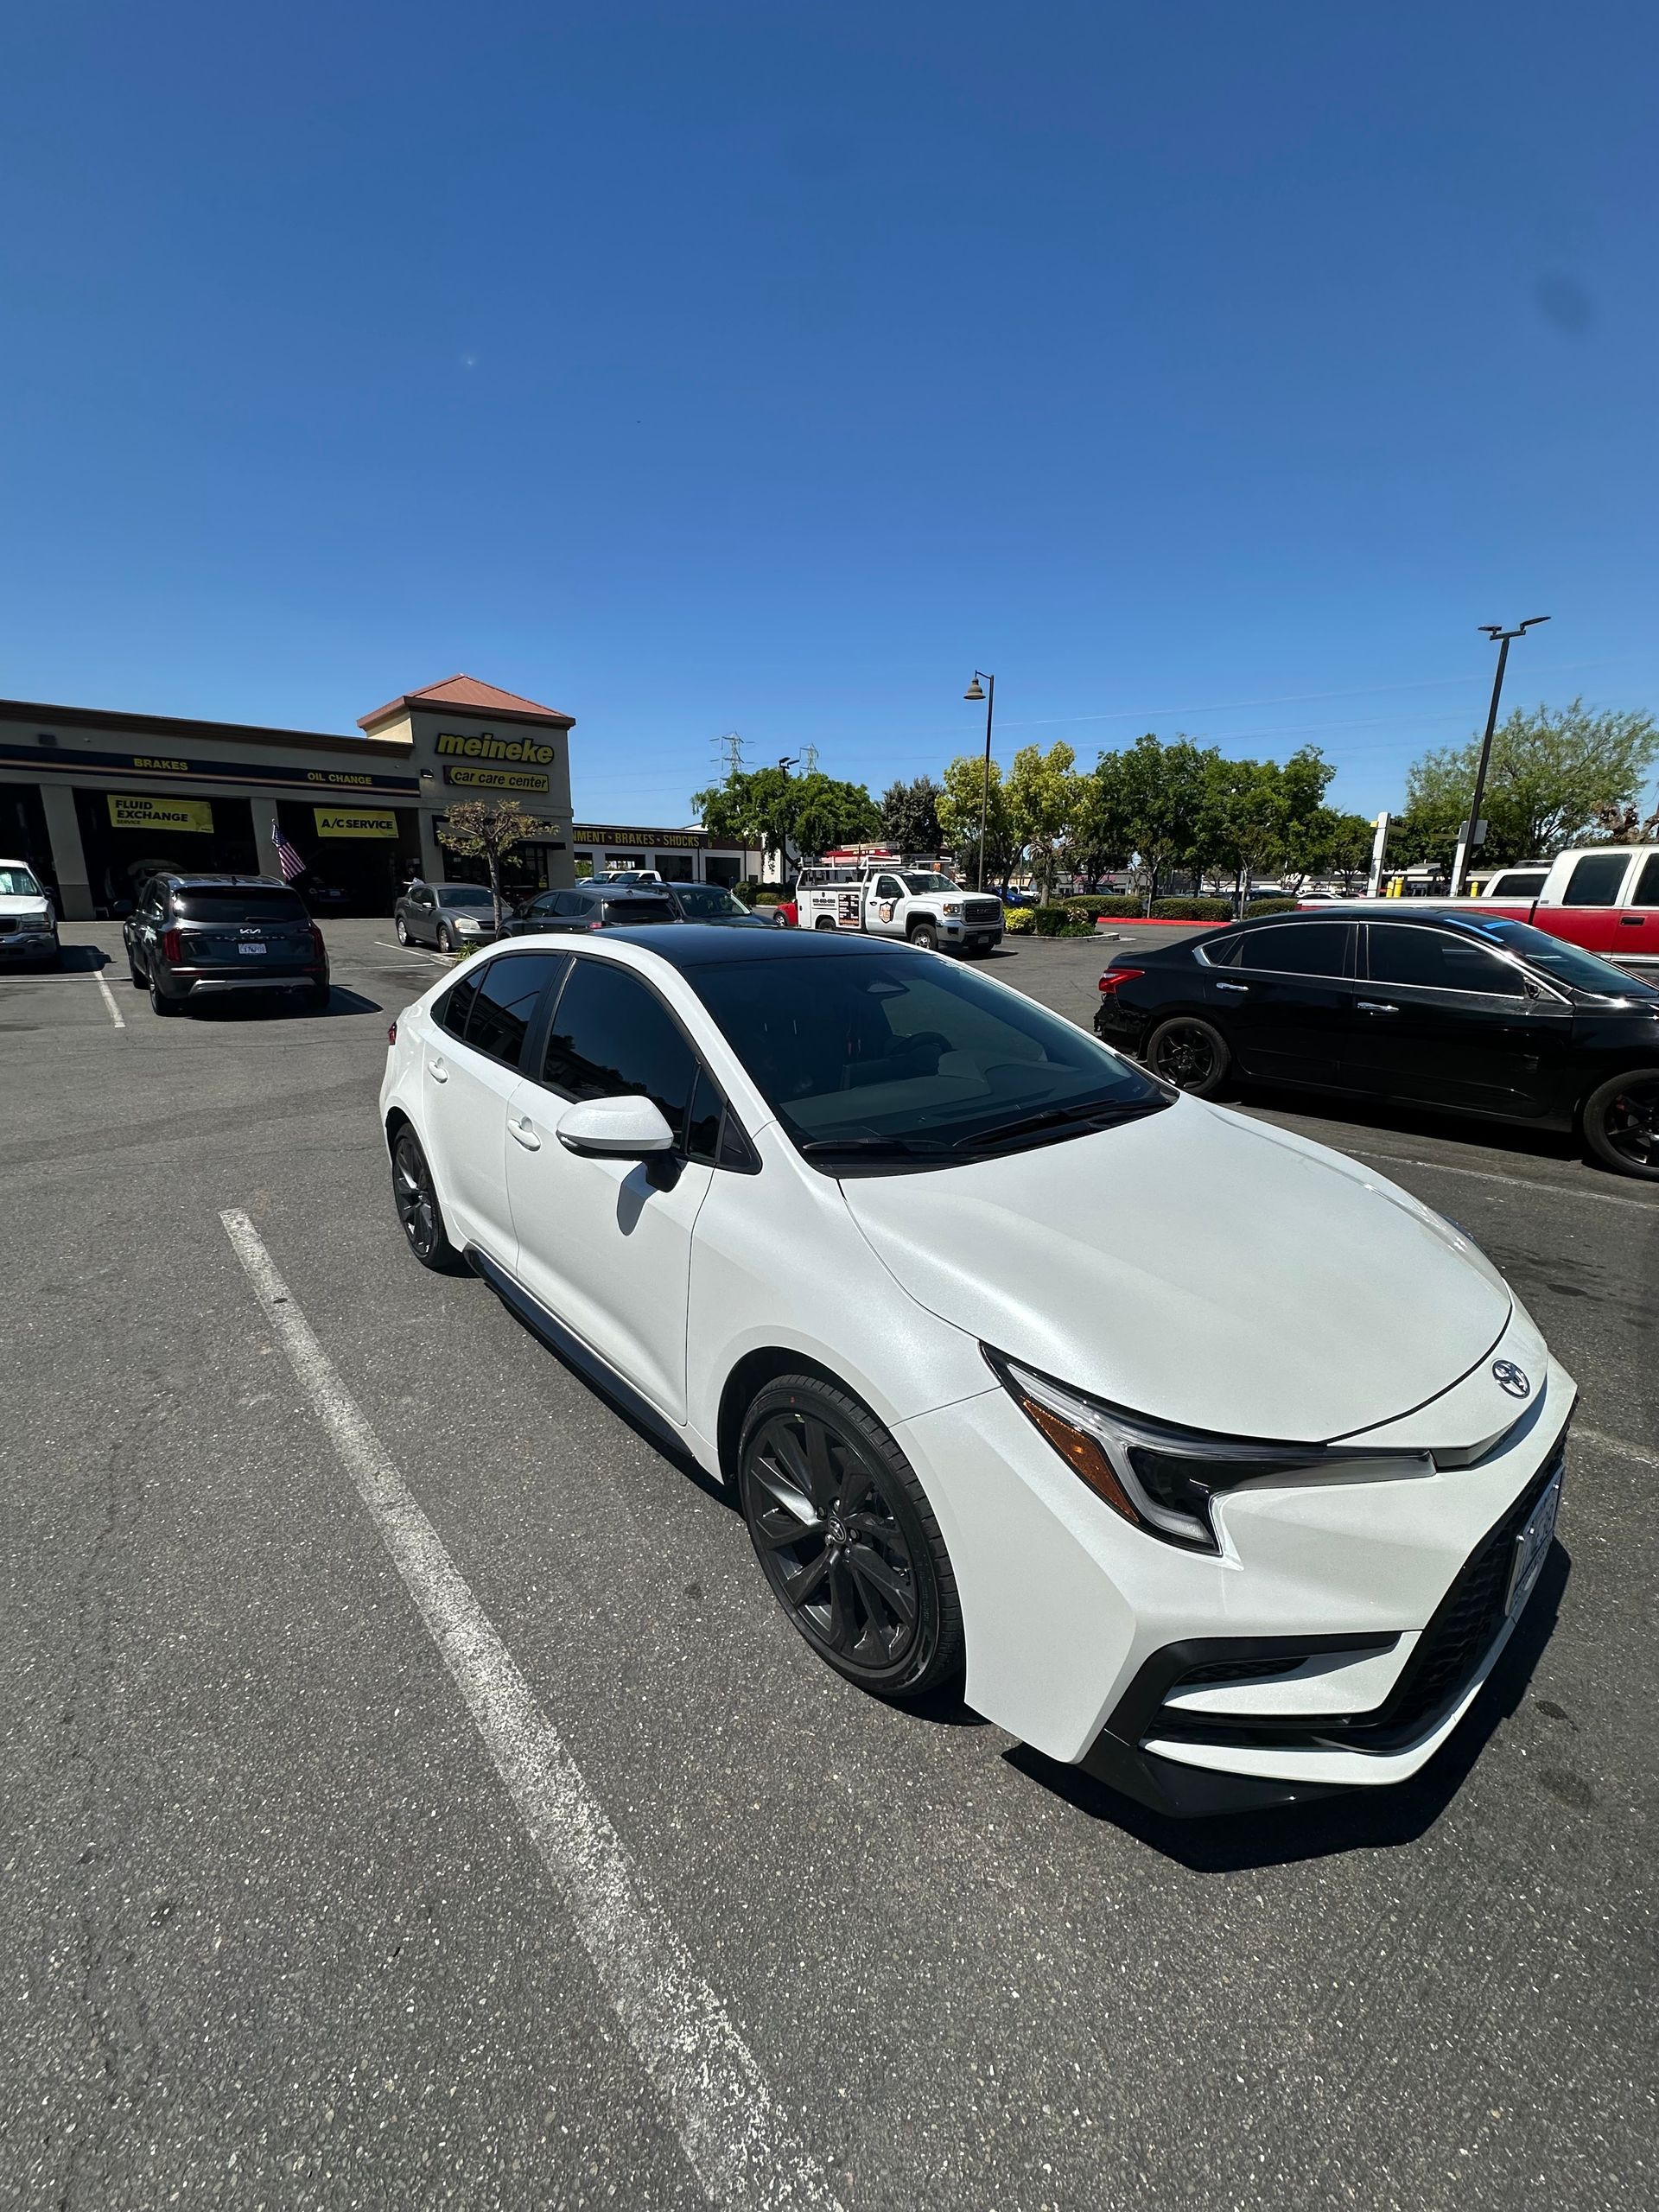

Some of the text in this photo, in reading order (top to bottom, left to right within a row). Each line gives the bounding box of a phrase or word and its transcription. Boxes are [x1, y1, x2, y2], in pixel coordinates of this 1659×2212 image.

[437, 734, 554, 764] meineke
[134, 758, 188, 770] BRAKES
[307, 772, 373, 785] OIL CHANGE
[454, 771, 547, 789] car care center
[115, 800, 154, 810] FLUID
[117, 810, 188, 822] EXCHANGE
[321, 817, 394, 830] A/C SERVICE
[615, 832, 655, 845] BRAKES
[663, 835, 700, 848] SHOCKS
